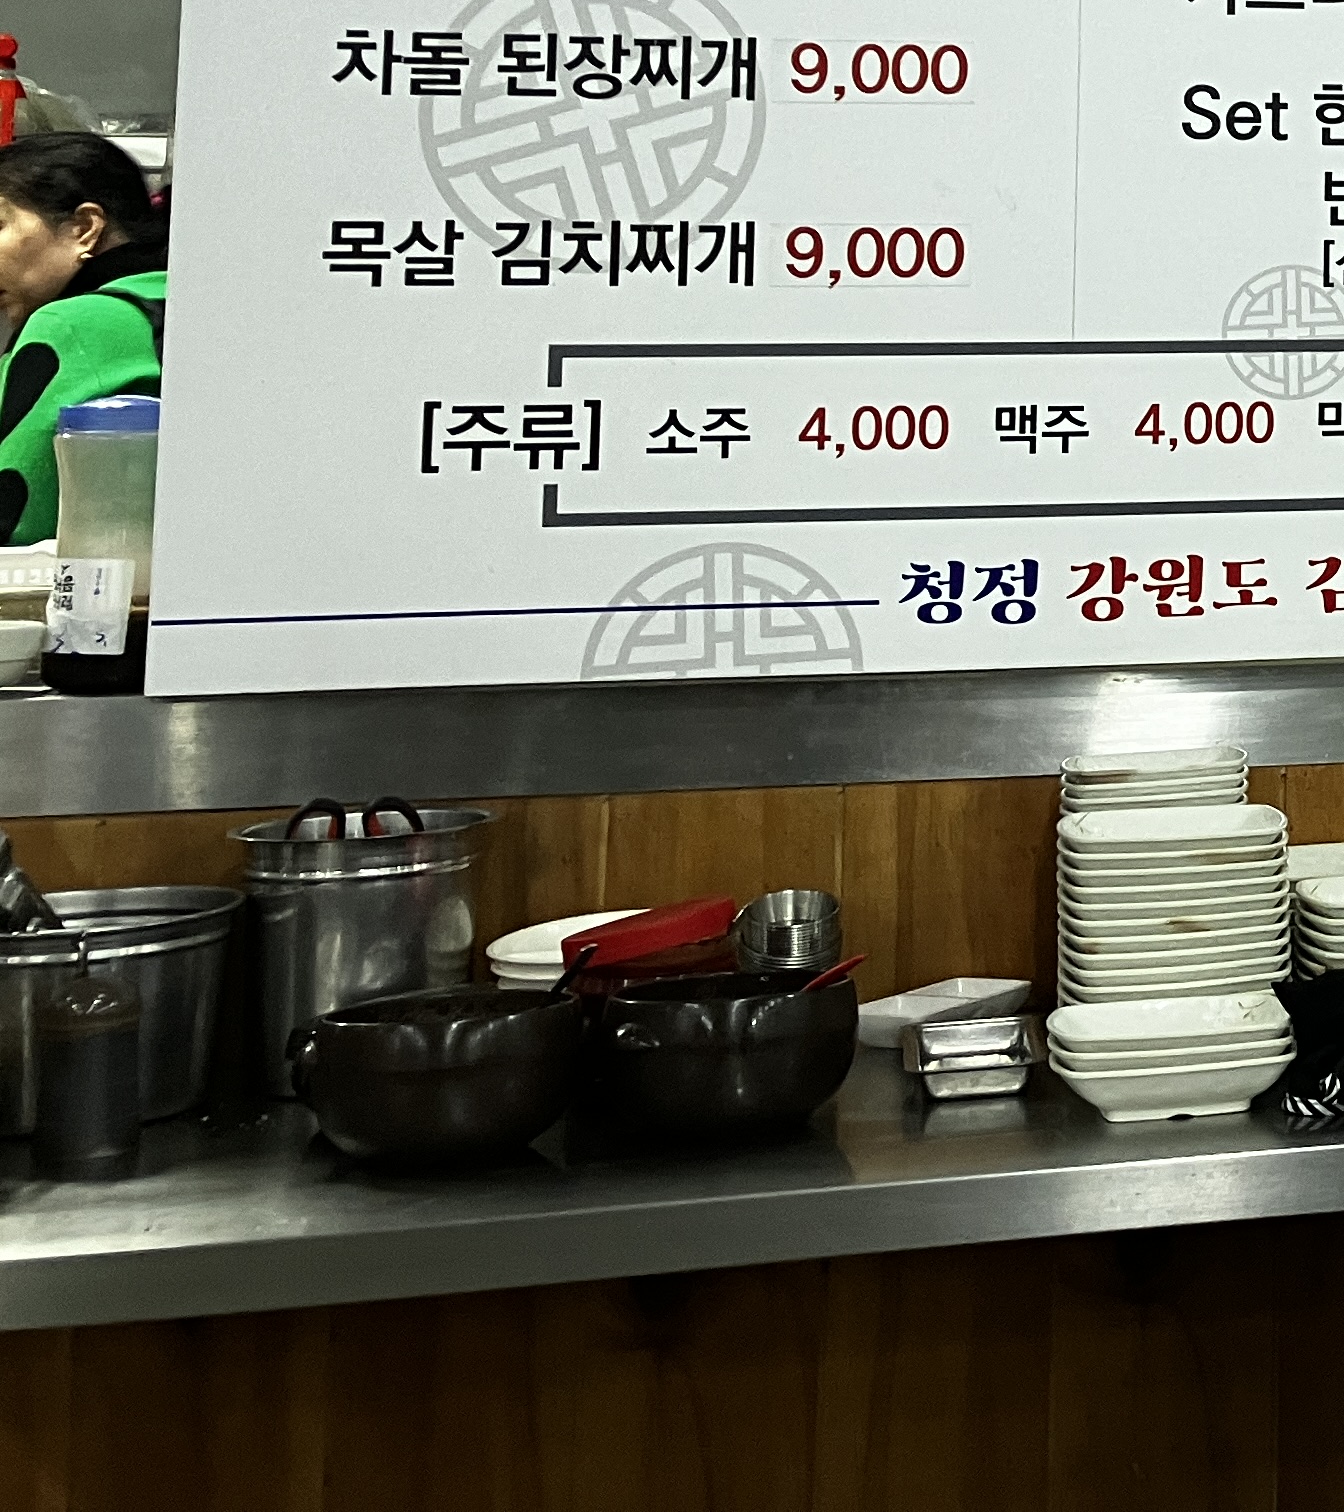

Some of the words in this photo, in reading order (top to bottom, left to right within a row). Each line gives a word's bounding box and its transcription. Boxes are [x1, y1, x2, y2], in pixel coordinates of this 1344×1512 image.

[331, 29, 470, 97] 차돌
[497, 32, 757, 102] 된장찌개
[790, 42, 969, 102] 9,000
[1181, 84, 1289, 142] Set
[321, 219, 465, 288] 목살
[491, 219, 756, 287] 김치찌개
[785, 226, 965, 289] 9,000
[420, 399, 602, 474] [주류]
[645, 407, 751, 459] 소주
[798, 404, 949, 459] 4,000
[995, 404, 1090, 455] 맥주
[1134, 400, 1275, 452] 4,000
[898, 558, 1039, 625] 청정
[1065, 554, 1278, 622] 강원도
